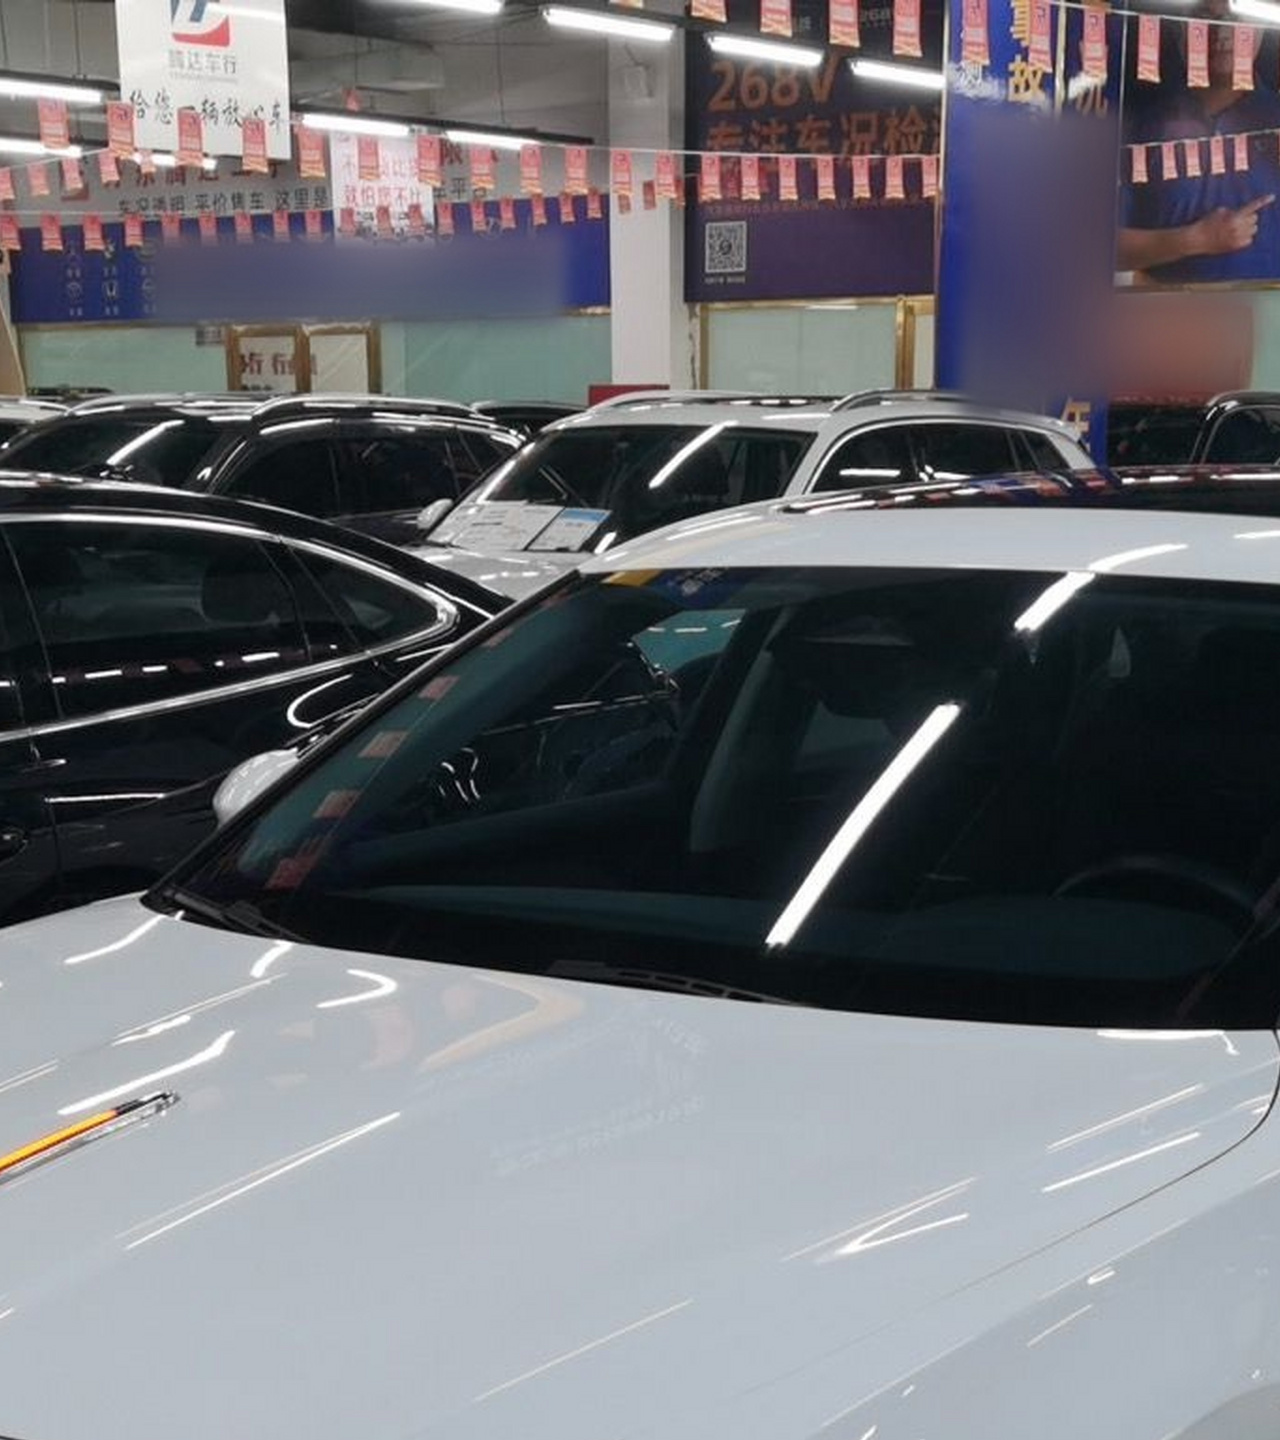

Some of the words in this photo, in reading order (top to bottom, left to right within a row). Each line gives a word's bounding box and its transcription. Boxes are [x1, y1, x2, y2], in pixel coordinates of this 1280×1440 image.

[705, 105, 939, 171] 专注车况检
